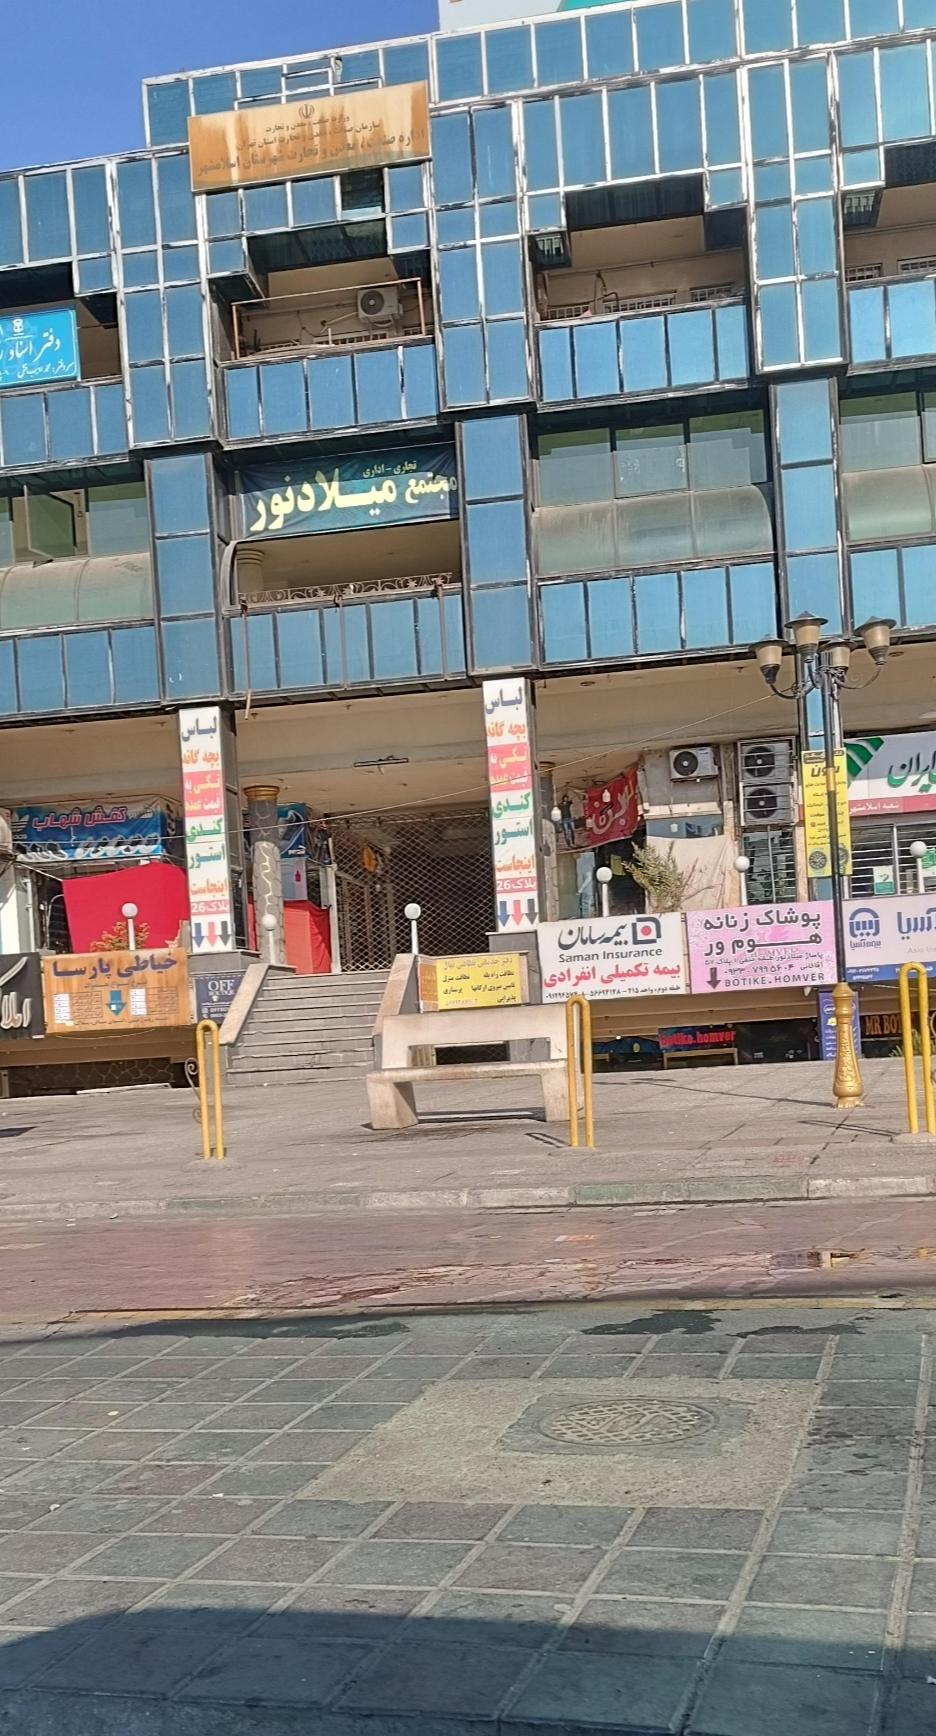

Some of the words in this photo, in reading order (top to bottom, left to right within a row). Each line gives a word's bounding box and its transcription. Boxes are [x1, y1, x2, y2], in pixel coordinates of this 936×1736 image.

[32, 327, 61, 363] دفتر
[362, 464, 385, 479] اداری
[393, 460, 417, 475] تجاری
[404, 471, 458, 504] مجتمع
[485, 686, 523, 715] لباس
[182, 715, 218, 743] لباس
[507, 723, 526, 740] بچه
[202, 751, 220, 768] بچه
[83, 804, 128, 827] کفش
[492, 792, 531, 818] کندی
[187, 818, 223, 842] کندی
[494, 818, 534, 846] استور
[188, 843, 226, 870] استور
[495, 853, 535, 875] اینجاست
[190, 878, 229, 897] اینجاست
[496, 879, 511, 891] 26
[703, 912, 750, 932] زنانه
[756, 907, 821, 929] پوشاک
[558, 925, 606, 951] سامان
[704, 939, 725, 956] ور
[731, 930, 823, 954] هوم
[117, 951, 178, 978] خیاطی
[558, 953, 600, 963] Saman
[602, 948, 663, 960] Insurance
[52, 957, 113, 980] پارسا
[543, 966, 597, 988] انفرادی
[600, 962, 650, 984] تکمیلی
[653, 963, 681, 979] بیمه
[208, 979, 235, 991] OFF
[724, 972, 826, 988] BOTIKE.HOMVER
